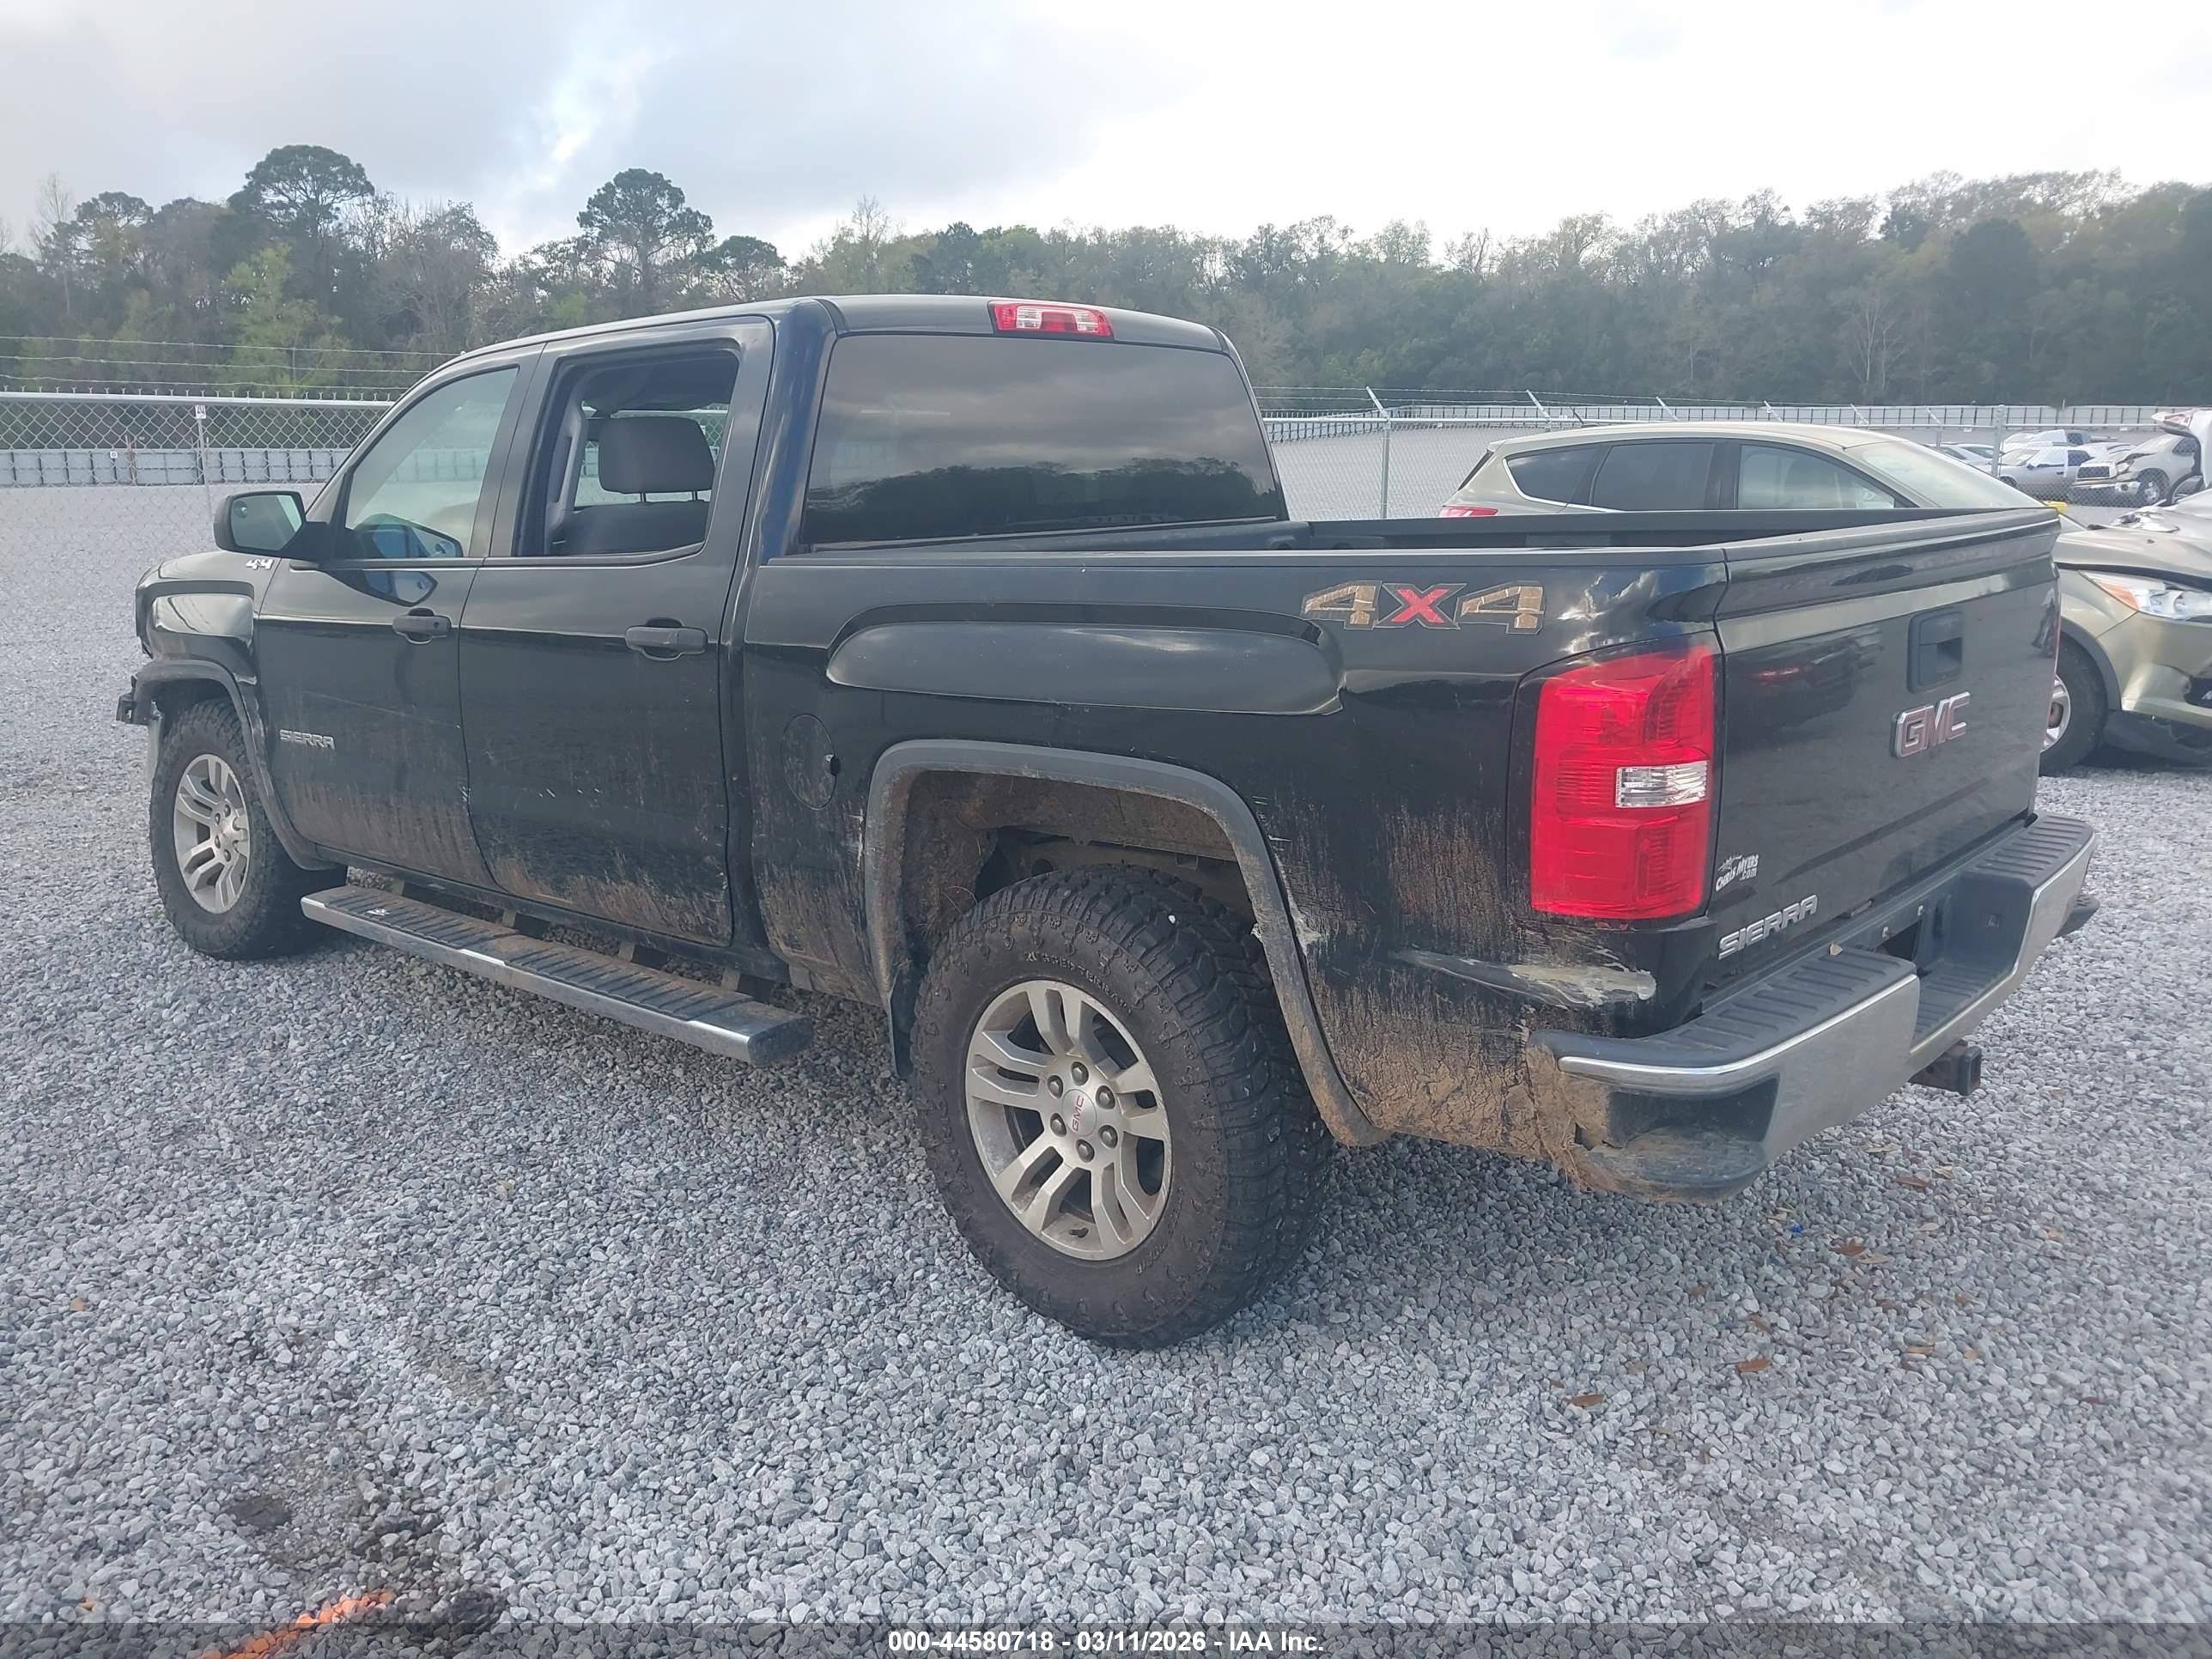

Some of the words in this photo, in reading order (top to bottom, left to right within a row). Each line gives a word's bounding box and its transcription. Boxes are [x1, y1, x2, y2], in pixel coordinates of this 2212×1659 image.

[279, 729, 336, 750] SIERRA
[1895, 690, 1971, 757] GMC
[1736, 854, 1759, 876] MYERS
[1718, 894, 1819, 960] SIERRA
[1072, 1095, 1085, 1132] GMC
